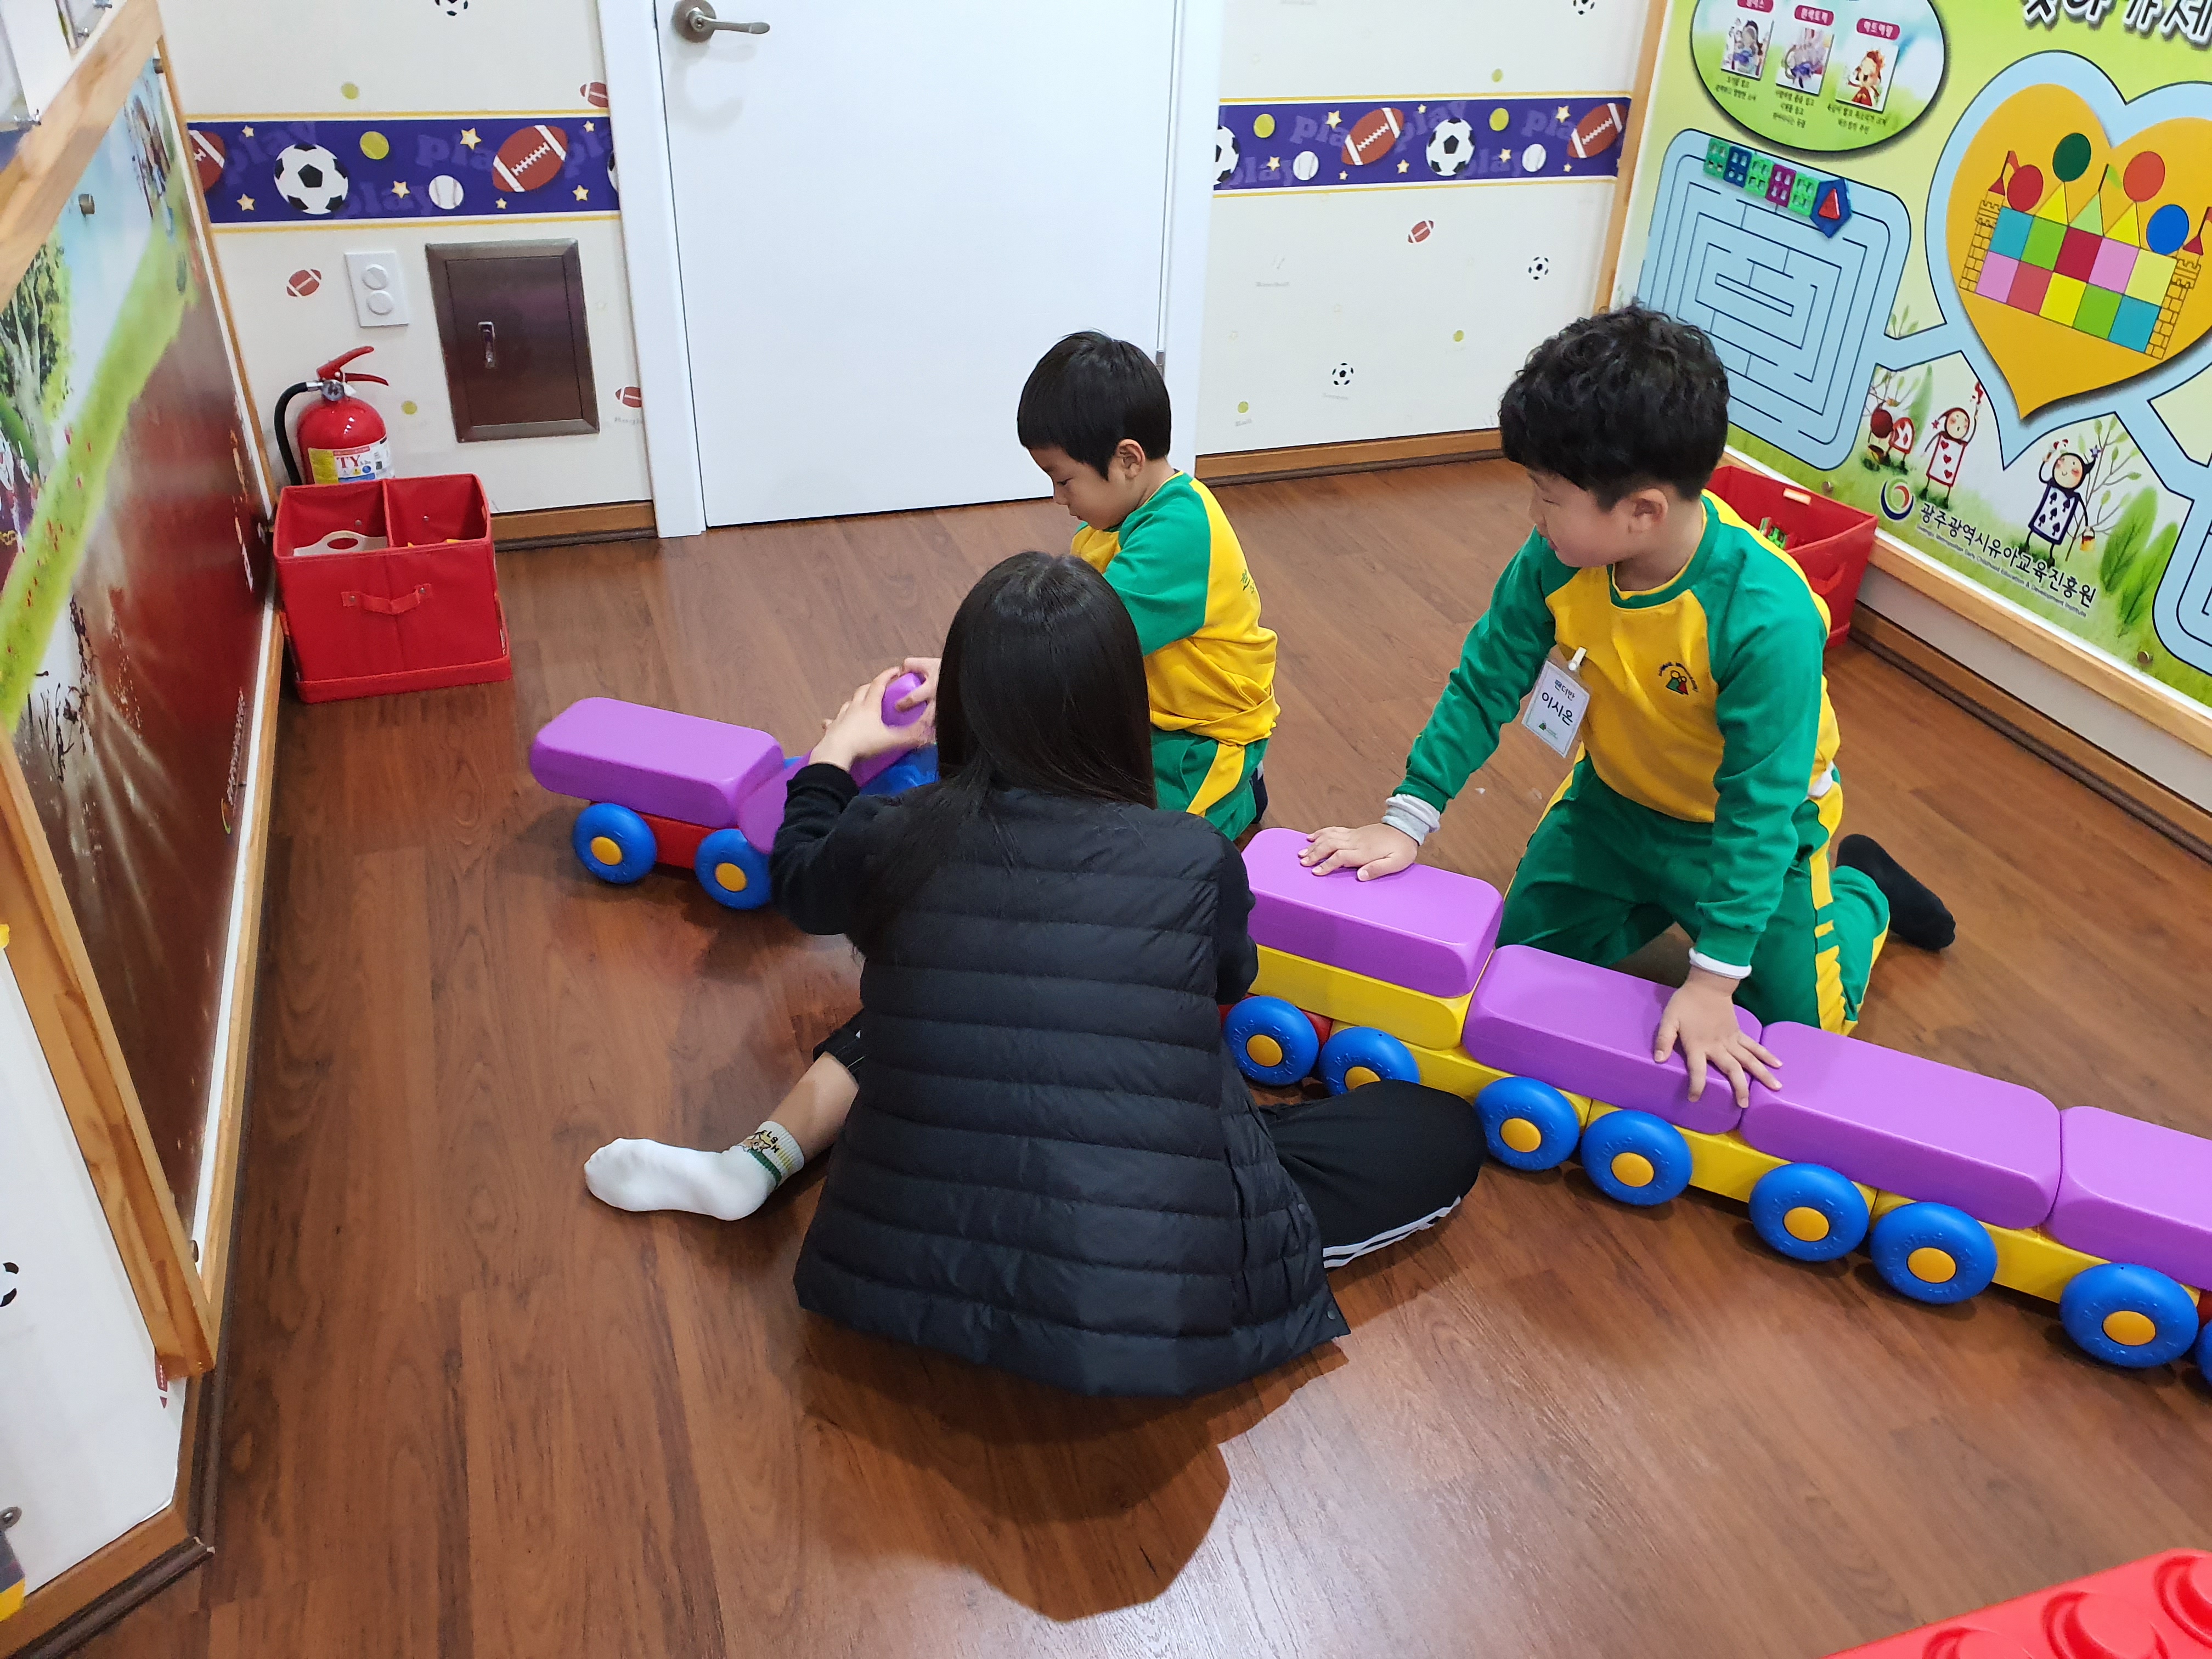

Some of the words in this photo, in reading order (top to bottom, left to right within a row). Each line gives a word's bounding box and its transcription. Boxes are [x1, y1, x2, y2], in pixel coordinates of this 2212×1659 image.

[1290, 115, 1350, 147] pla
[416, 133, 495, 171] pla
[1921, 503, 2096, 608] 광주광역시유아교육진흥원
[1542, 692, 1573, 726] 이시온
